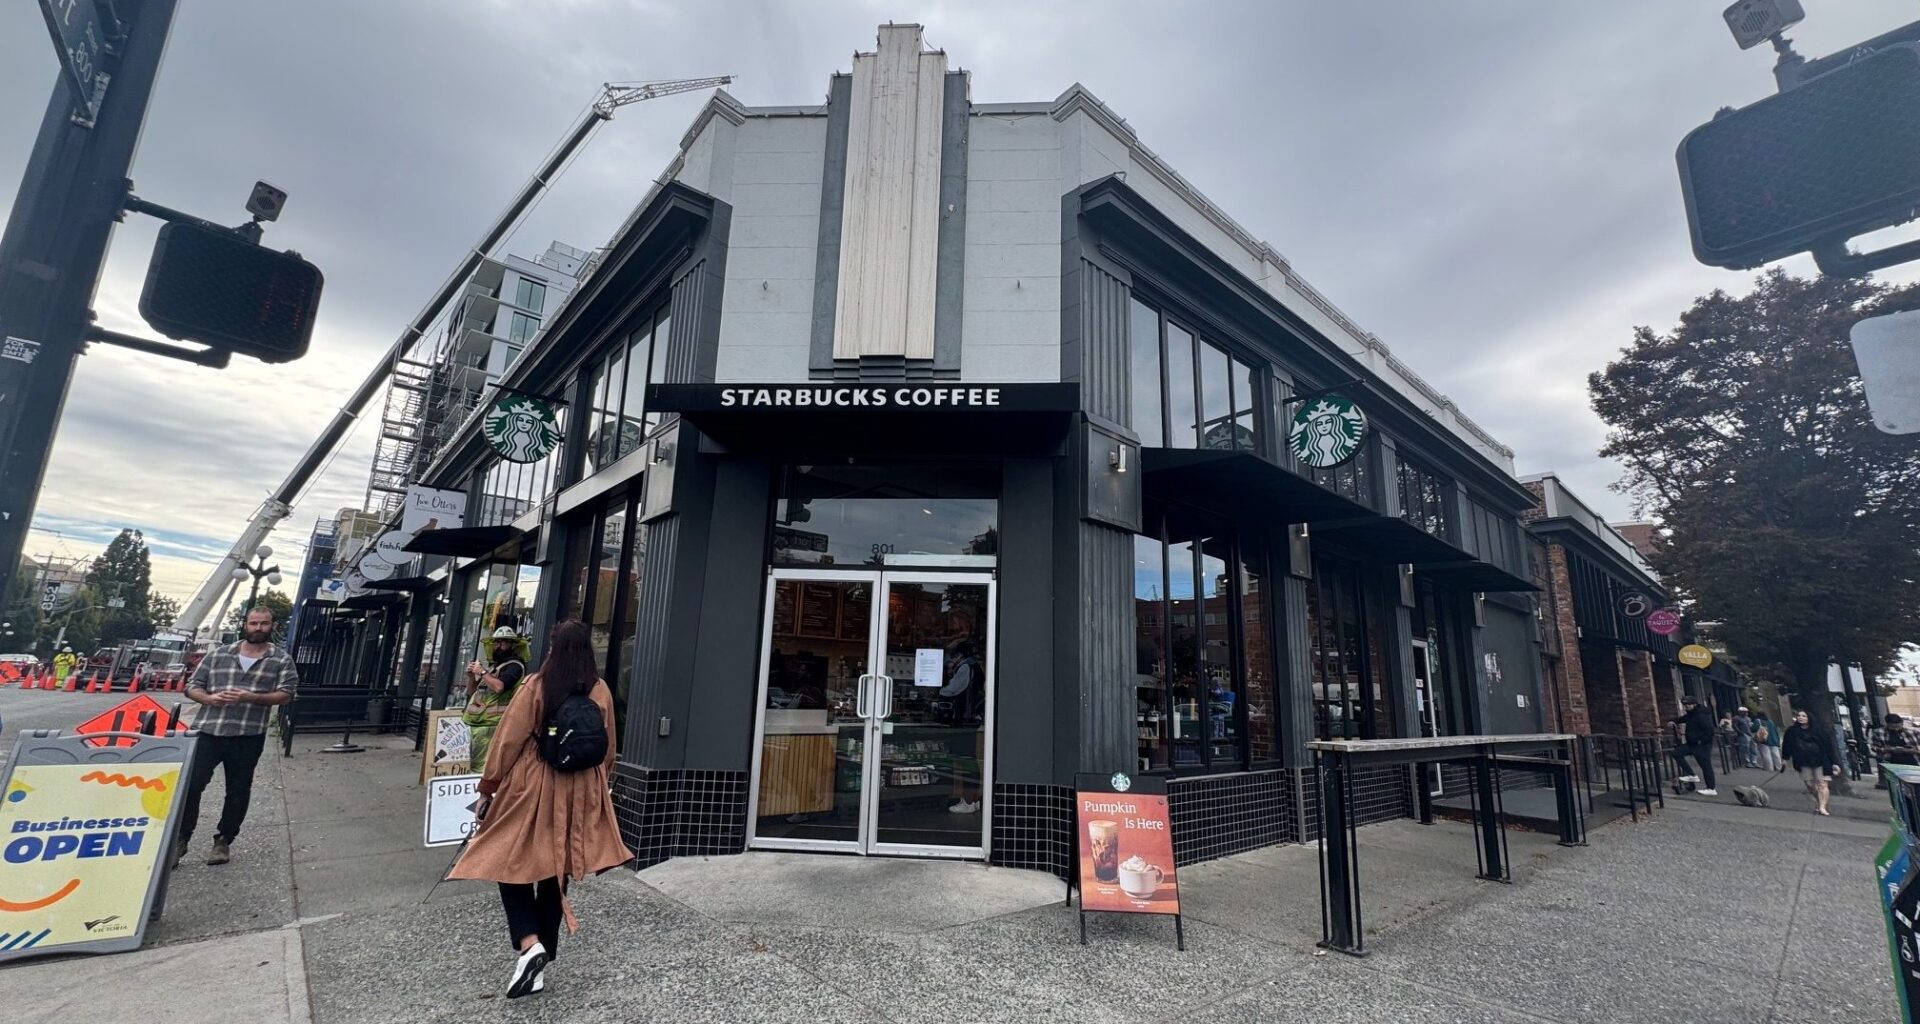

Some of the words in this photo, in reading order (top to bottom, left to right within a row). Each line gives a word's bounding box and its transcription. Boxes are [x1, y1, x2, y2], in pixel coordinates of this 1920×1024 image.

[76, 42, 92, 83] 800
[720, 388, 887, 407] STARBUCKS
[894, 388, 1001, 407] COFFEE
[871, 543, 895, 555] 801
[41, 586, 59, 611] 852
[1084, 800, 1137, 816] Pumpkin
[11, 816, 150, 834] Businesses
[1125, 817, 1135, 829] Is
[1136, 817, 1164, 831] Here
[3, 831, 145, 864] OPEN
